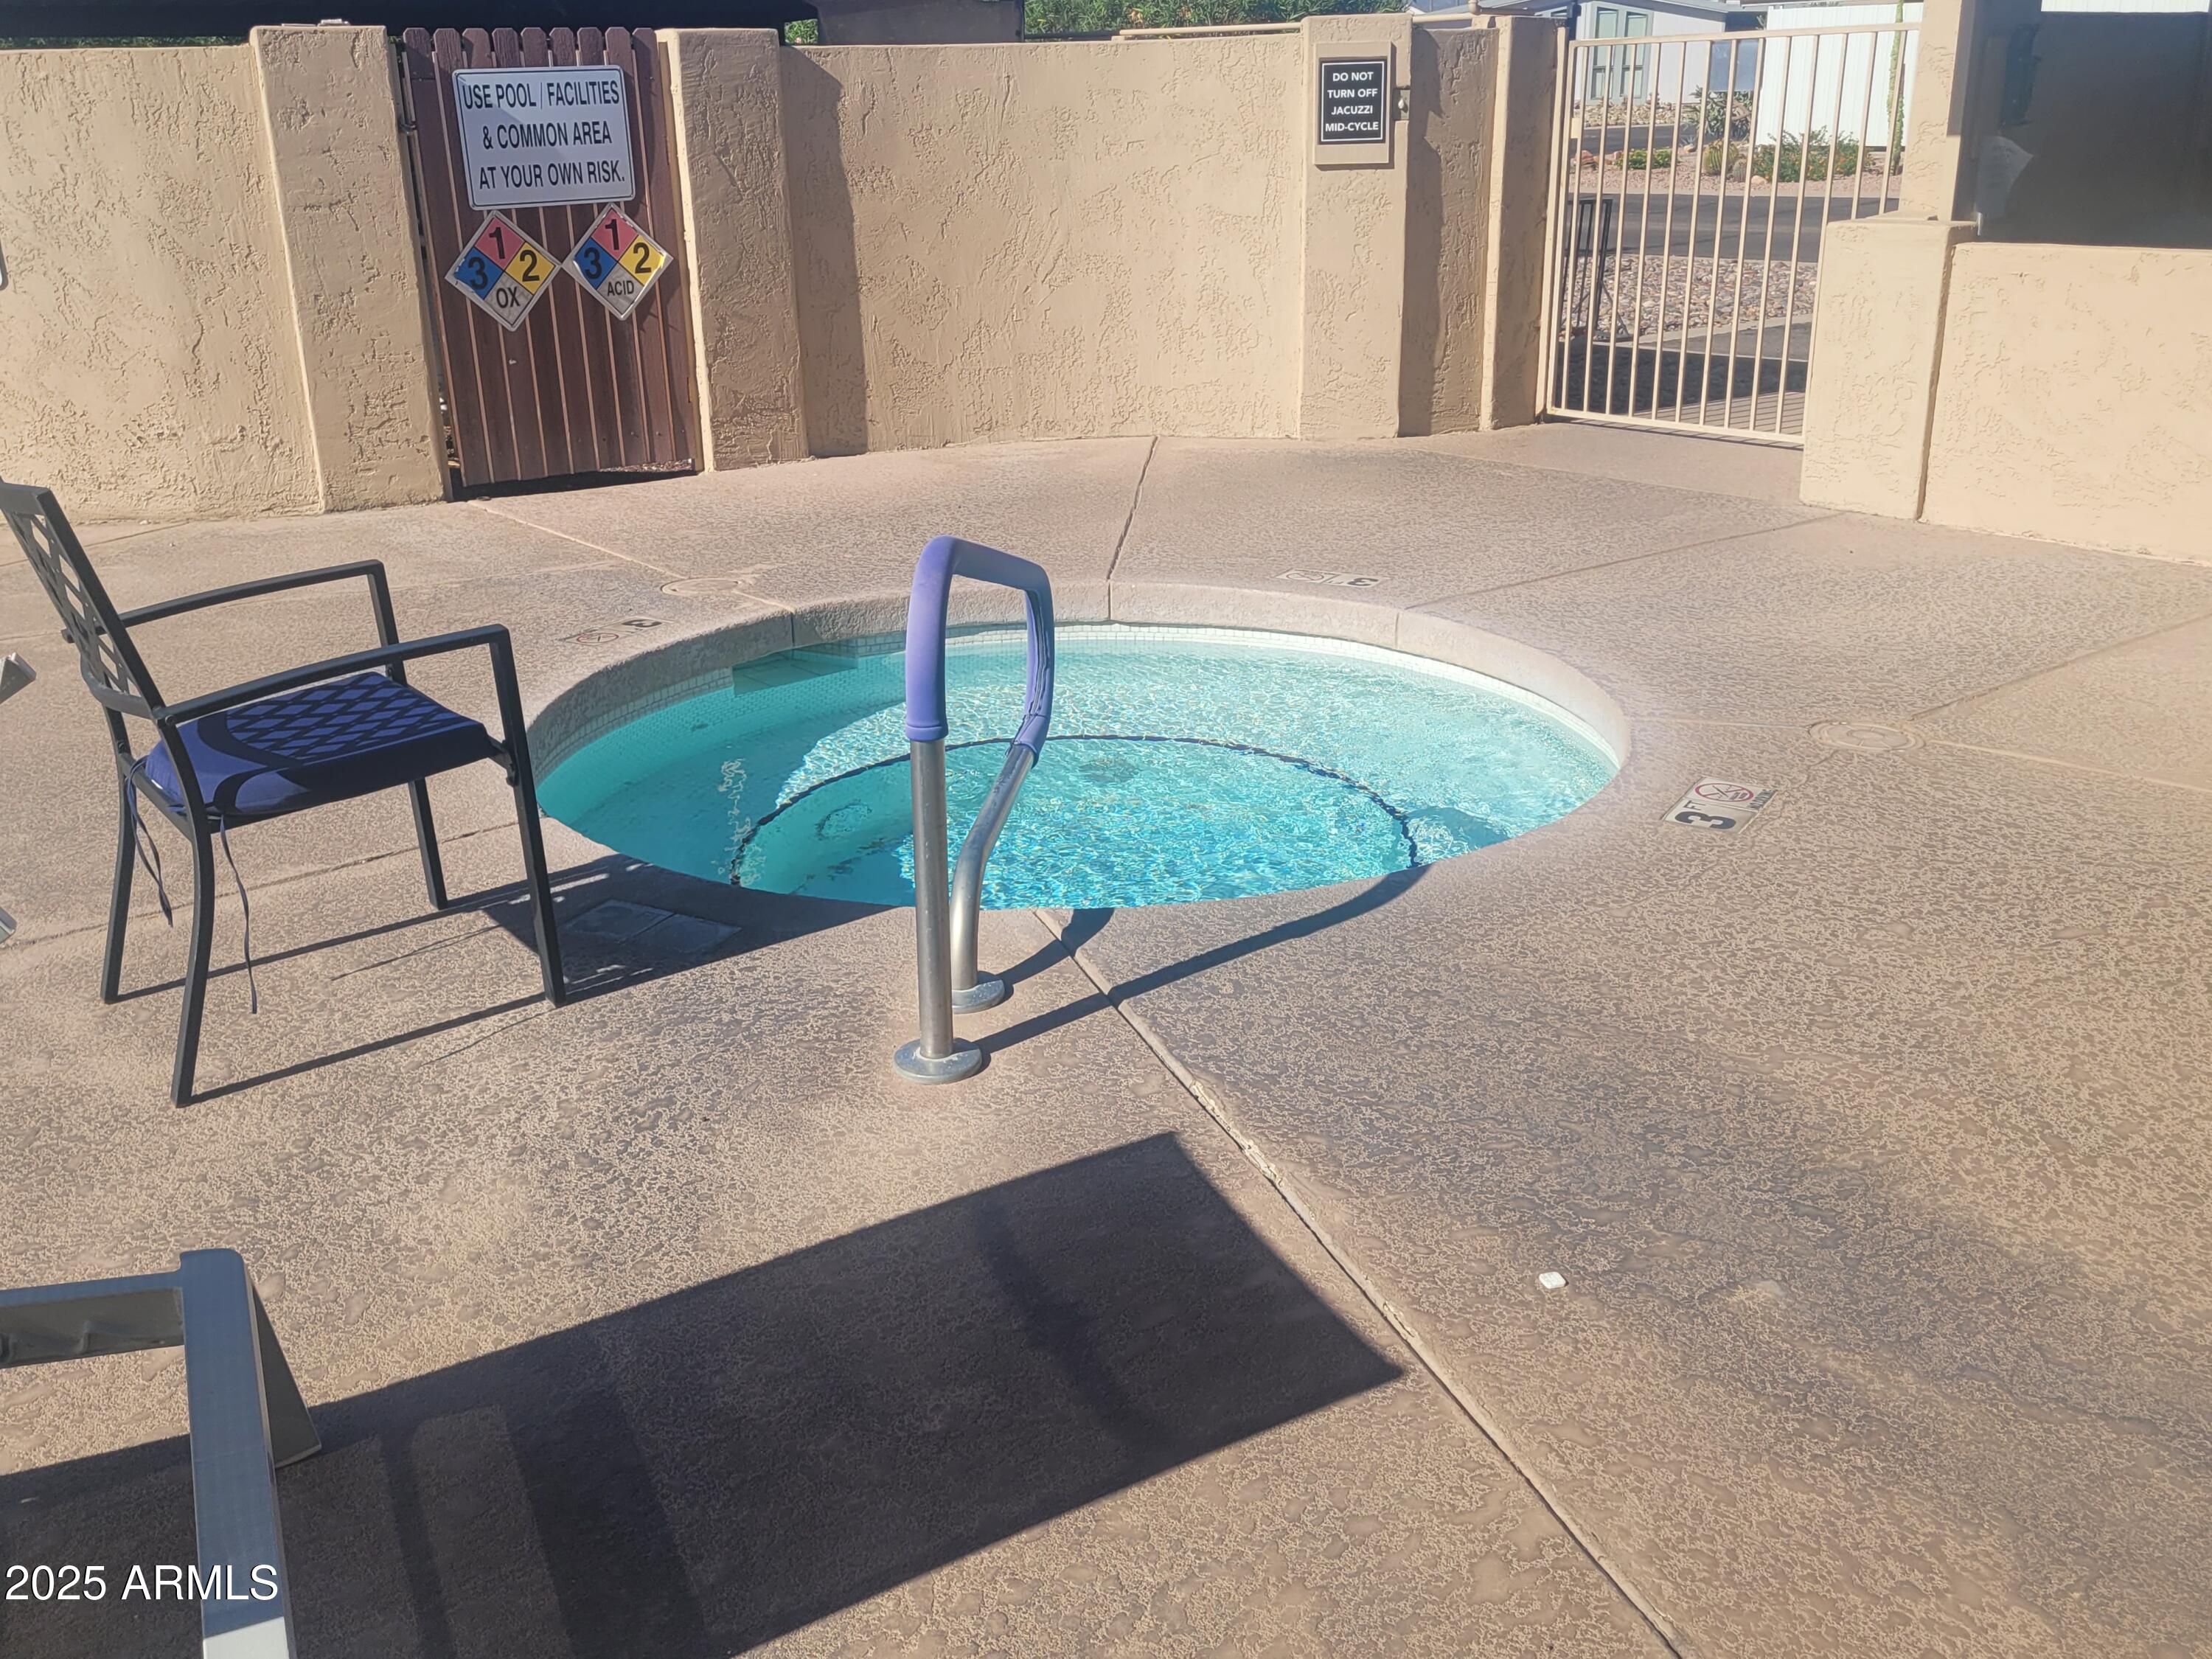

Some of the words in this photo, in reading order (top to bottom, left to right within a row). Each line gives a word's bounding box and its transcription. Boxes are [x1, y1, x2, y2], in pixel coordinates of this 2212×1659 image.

[1332, 72, 1349, 82] DO
[1351, 72, 1374, 81] NOT
[462, 84, 493, 109] USE
[495, 83, 537, 108] POOL
[546, 80, 619, 106] FACILITIES
[1327, 89, 1355, 99] TURN
[1357, 88, 1378, 97] OFF
[1331, 105, 1373, 115] JACUZZI
[482, 125, 494, 150] &
[497, 122, 568, 149] COMMON
[573, 120, 612, 145] AREA
[1325, 122, 1379, 132] MID-CYCLE
[479, 167, 496, 189] AT
[501, 164, 543, 188] YOUR
[548, 161, 583, 185] OWN
[586, 159, 625, 184] RISK.
[489, 227, 505, 260] 1
[605, 218, 619, 251] 1
[468, 257, 488, 290] 3
[519, 249, 540, 282] 2
[583, 247, 602, 279] 3
[633, 242, 652, 274] 2
[496, 286, 521, 308] OX
[606, 280, 634, 296] ACID
[1683, 799, 1706, 811] FT
[1674, 810, 1737, 830] 3
